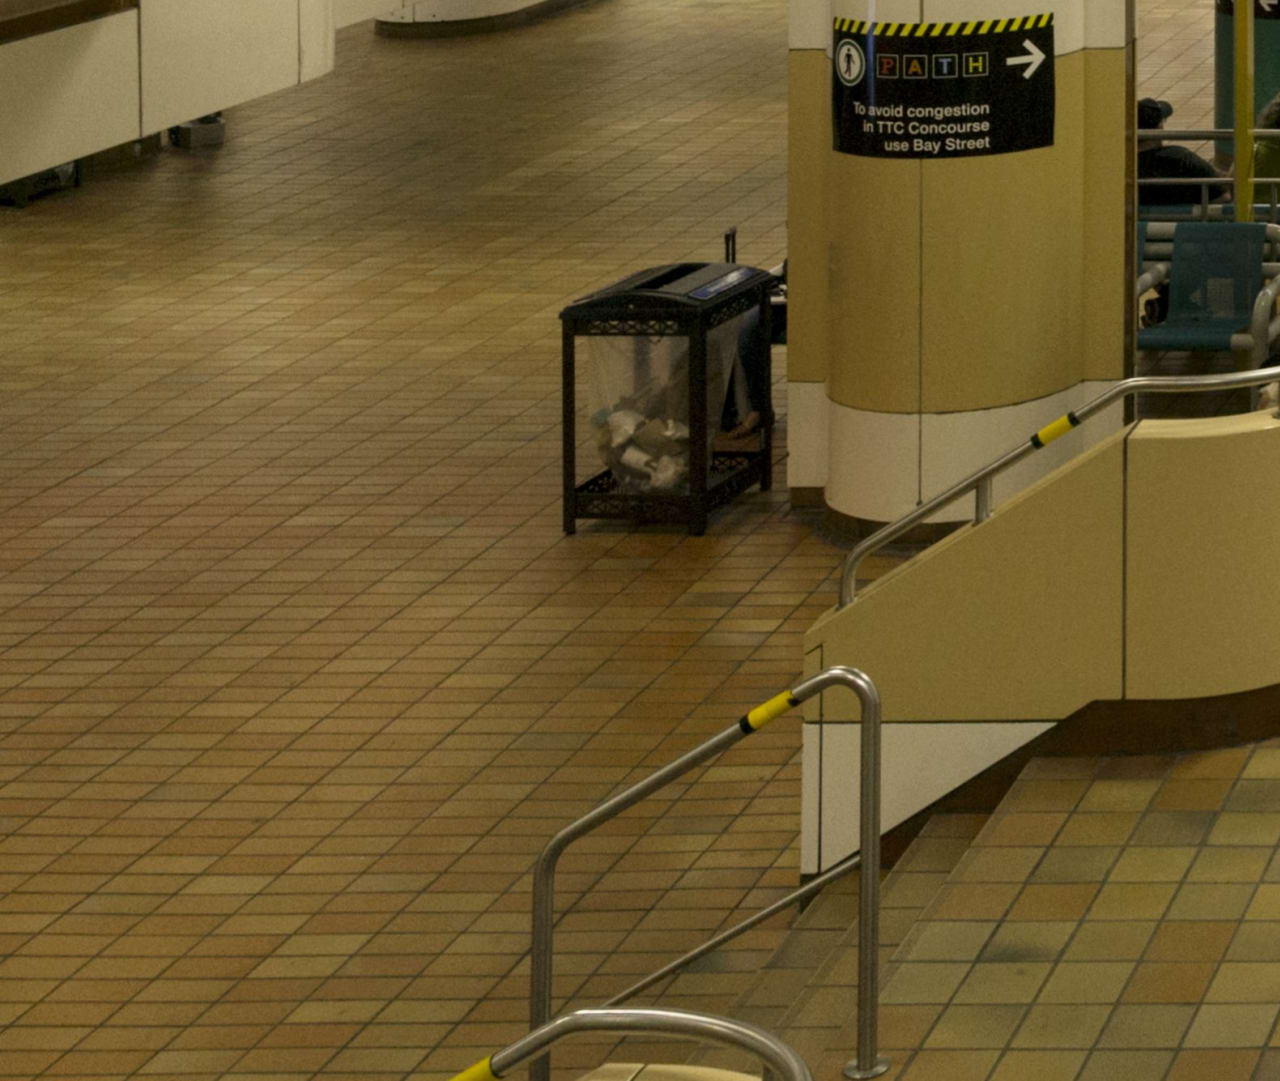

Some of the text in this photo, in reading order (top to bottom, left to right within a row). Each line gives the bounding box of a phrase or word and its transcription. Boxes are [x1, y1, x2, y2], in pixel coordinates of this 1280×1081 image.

[853, 101, 990, 120] To avoid congestion
[863, 120, 990, 135] in TTC Concourse
[884, 136, 990, 154] use Bay Street
